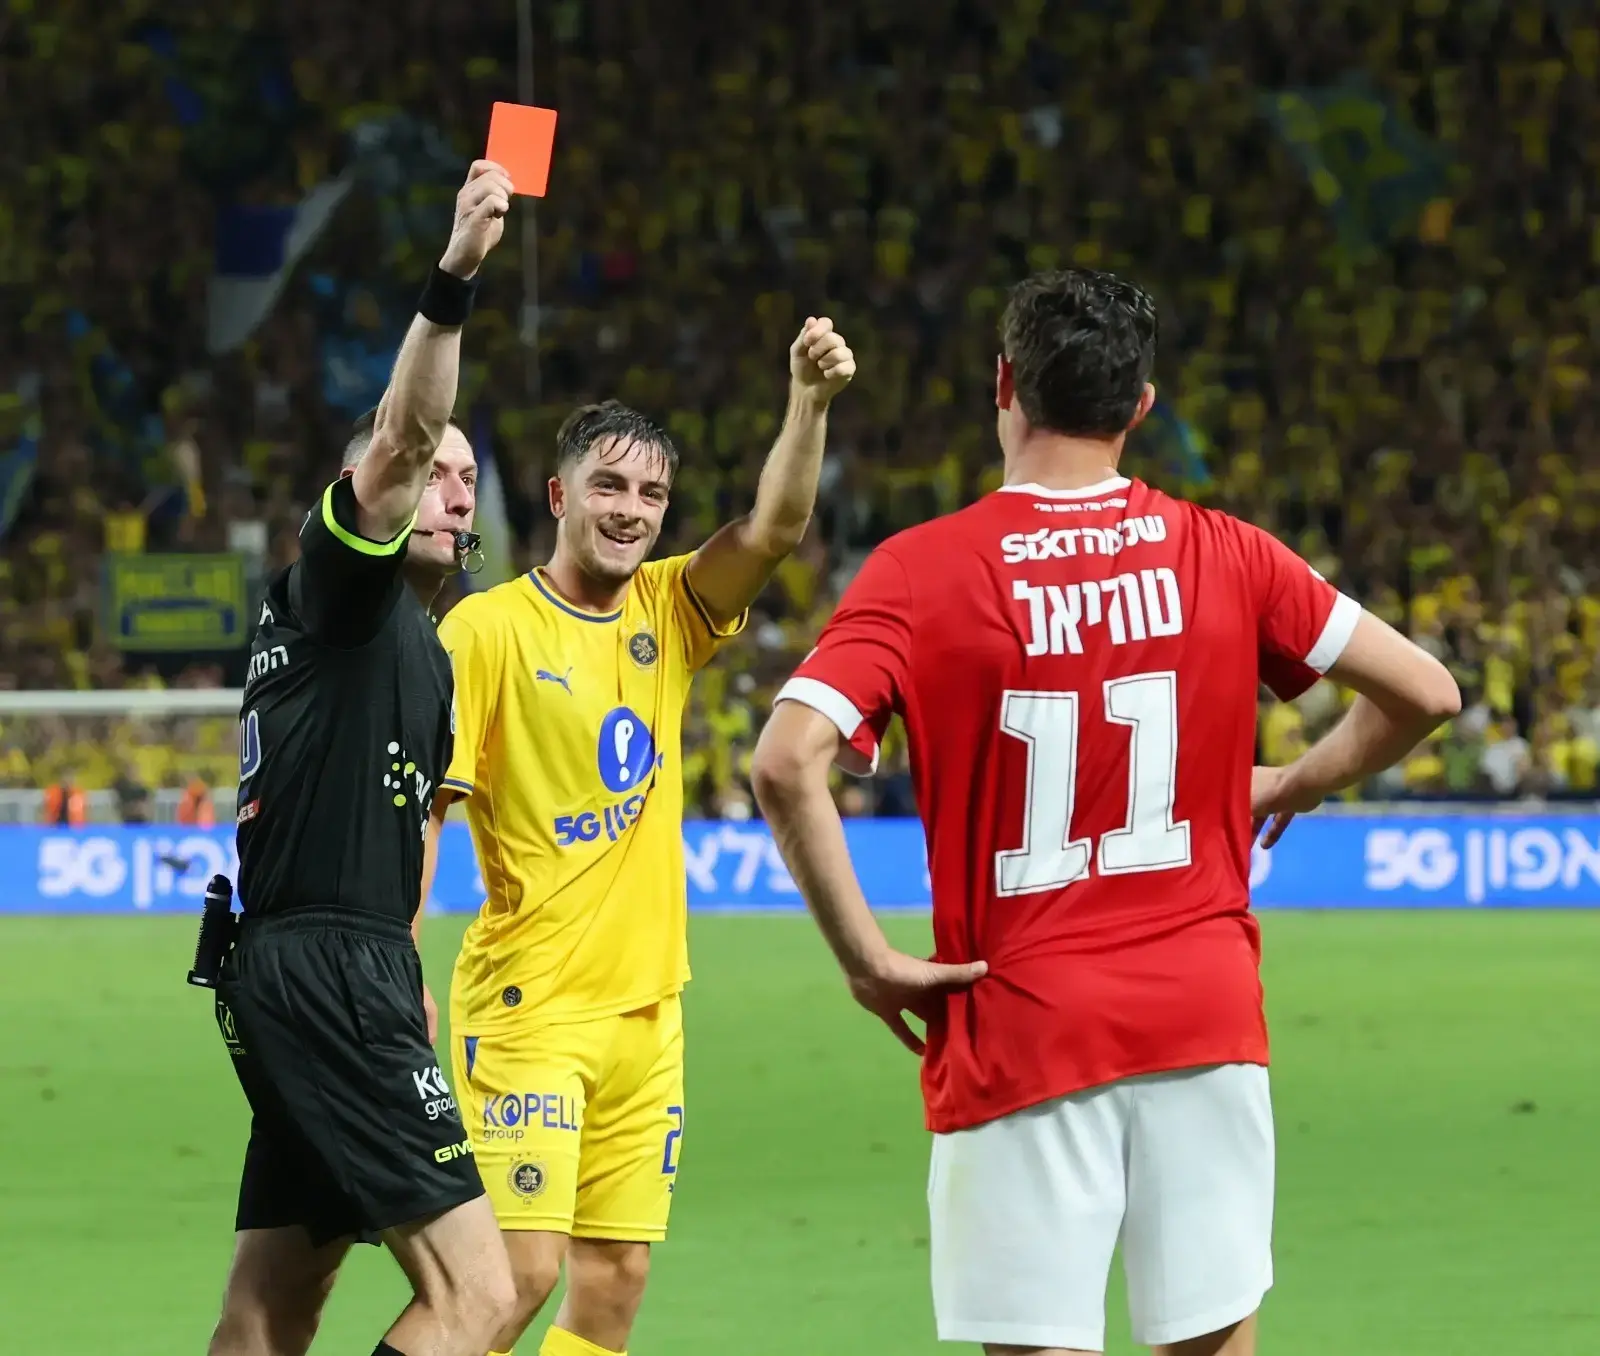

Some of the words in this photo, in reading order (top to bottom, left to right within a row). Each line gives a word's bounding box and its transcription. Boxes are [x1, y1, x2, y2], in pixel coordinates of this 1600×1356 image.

[1012, 567, 1184, 656] טוריאל
[995, 669, 1192, 898] 11
[554, 812, 601, 845] 5G
[37, 836, 127, 897] 5G
[1364, 828, 1459, 891] 5G
[483, 1093, 578, 1131] KOPELL
[483, 1127, 524, 1142] group
